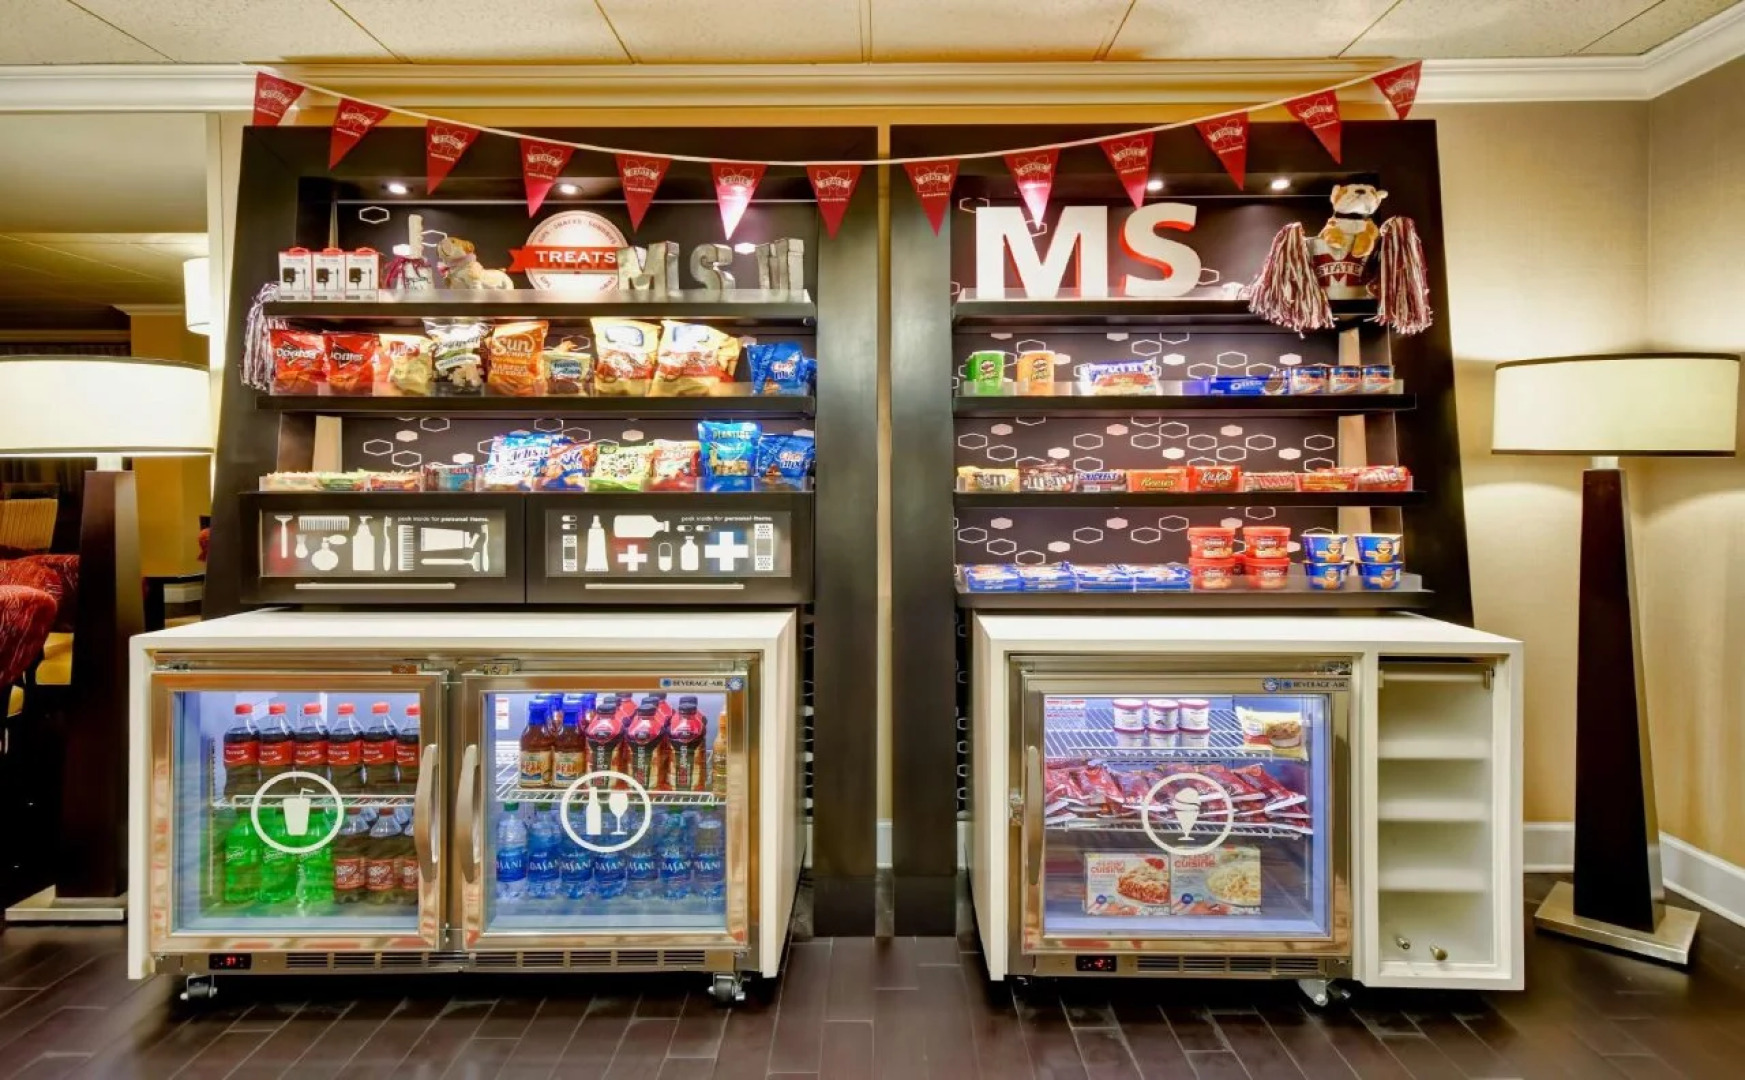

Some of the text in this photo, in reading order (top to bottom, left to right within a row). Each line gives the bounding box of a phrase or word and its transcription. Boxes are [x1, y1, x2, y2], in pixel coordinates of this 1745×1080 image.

[535, 250, 617, 264] TREATS
[975, 202, 1202, 300] MS
[1316, 260, 1363, 278] STATE
[493, 336, 530, 355] Sun
